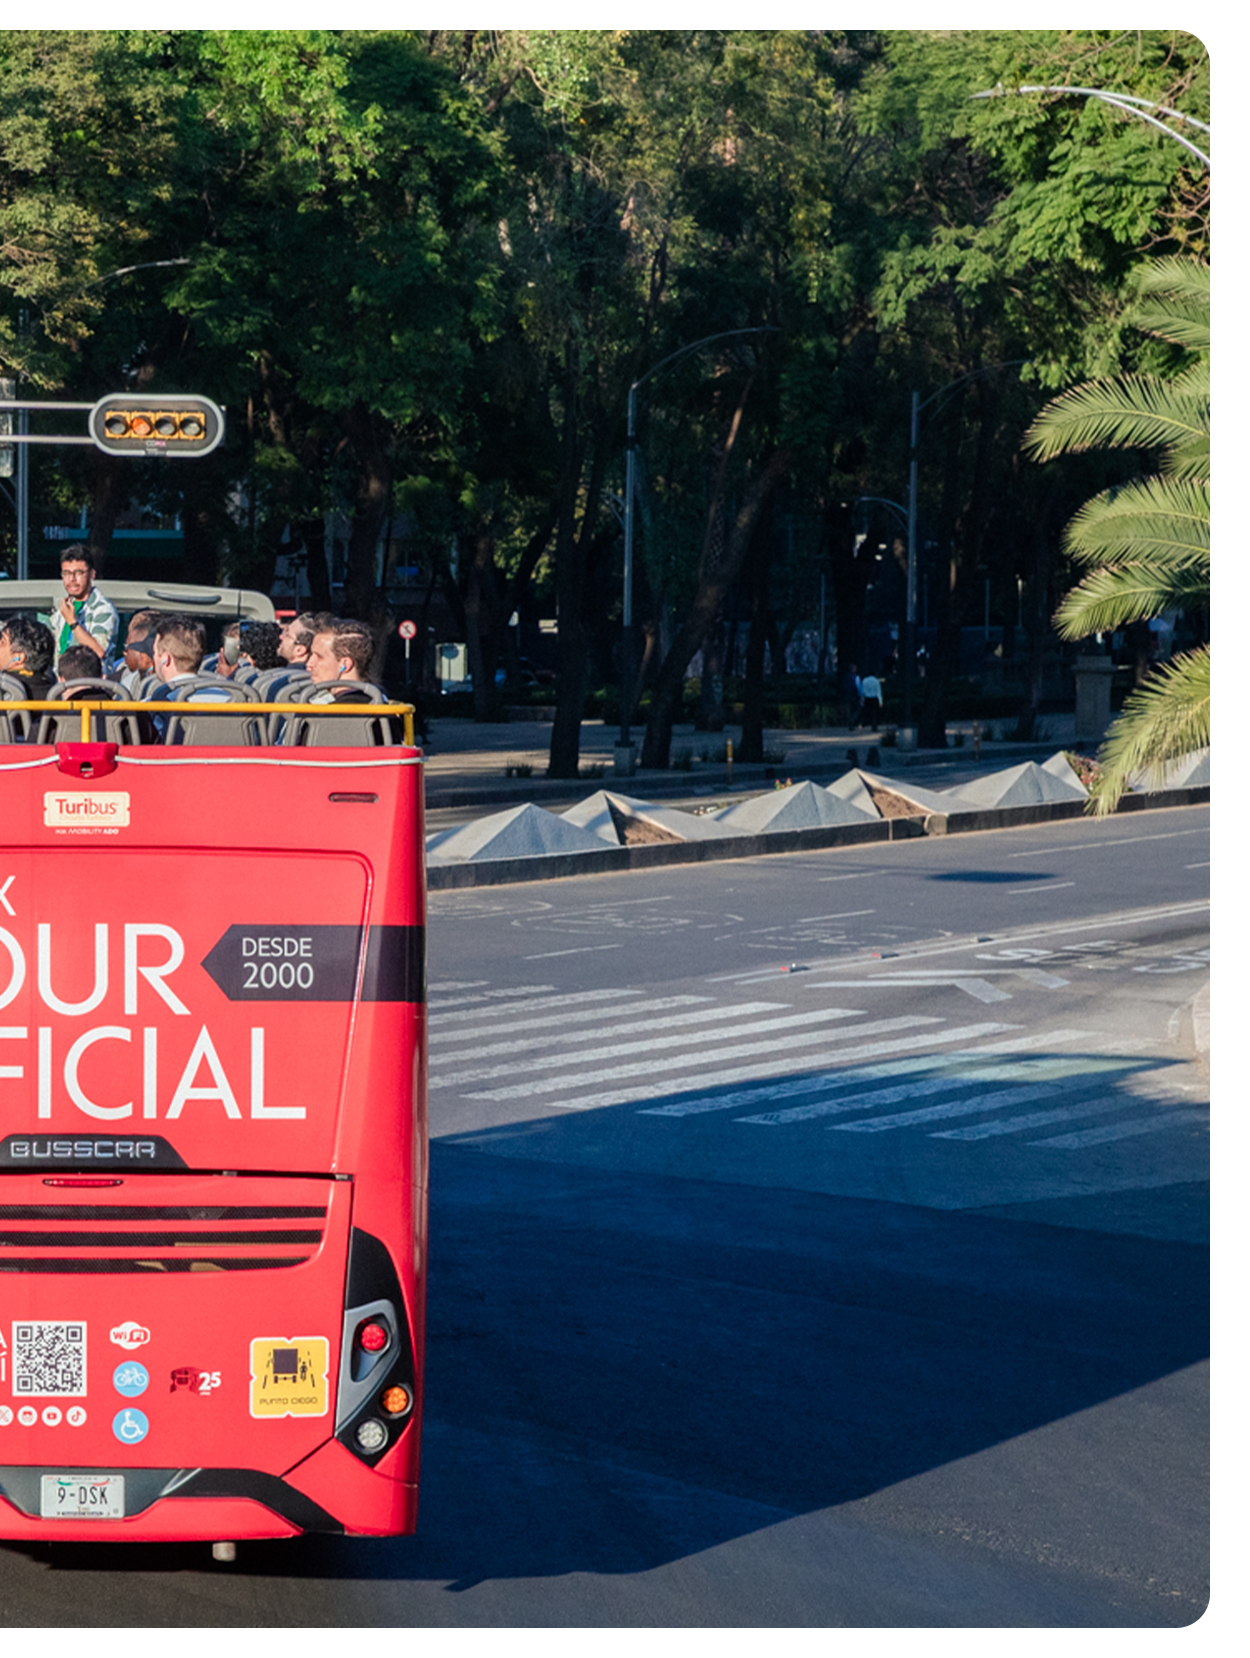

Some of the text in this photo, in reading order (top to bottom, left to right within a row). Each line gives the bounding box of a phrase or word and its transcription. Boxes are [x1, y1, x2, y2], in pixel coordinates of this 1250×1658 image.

[55, 798, 117, 815] Turibus
[242, 937, 312, 957] DESDE
[242, 962, 314, 989] 2000
[10, 1141, 156, 1158] BUSSCAR
[198, 1372, 221, 1391] 25
[57, 1486, 108, 1504] 9-DSK
